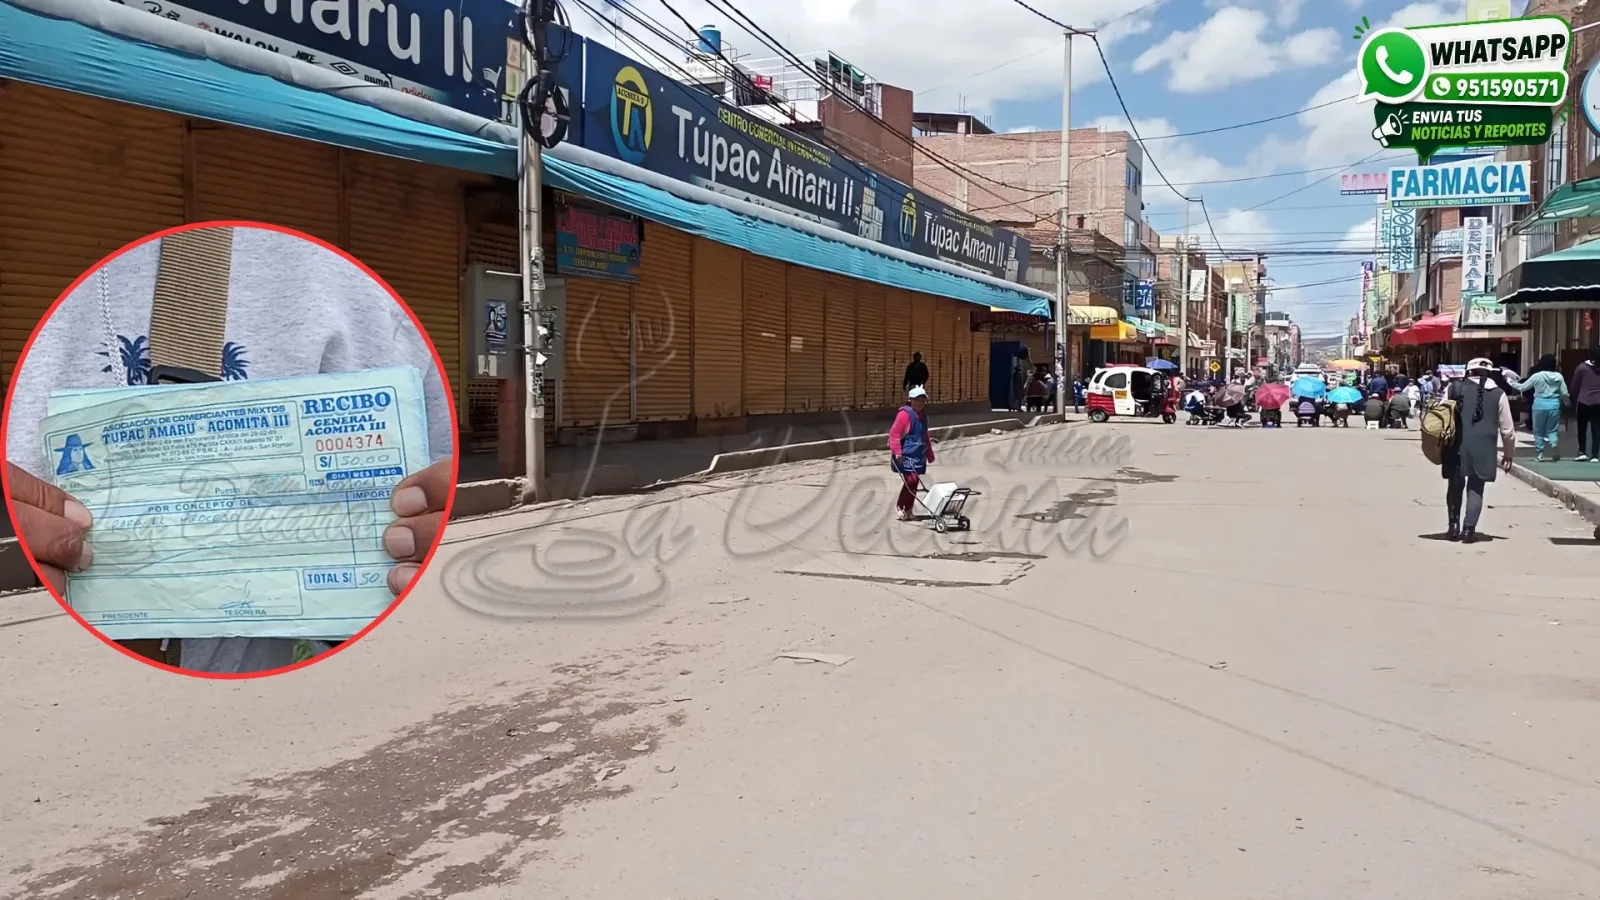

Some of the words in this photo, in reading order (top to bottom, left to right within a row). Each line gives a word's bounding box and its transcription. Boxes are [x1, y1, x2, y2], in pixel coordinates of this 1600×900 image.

[237, 0, 420, 64] aru
[718, 107, 747, 132] CENTRO
[749, 122, 786, 149] COMERCIAL
[671, 104, 760, 182] Túpac
[766, 148, 837, 211] Amaru
[1391, 165, 1527, 197] FARMACIA
[924, 211, 960, 255] Túpac
[961, 229, 996, 264] Amaru
[1465, 219, 1483, 289] DENTAL
[303, 391, 392, 414] RECIBO
[159, 416, 171, 424] DE
[172, 408, 246, 423] COMERCIANTES
[247, 404, 286, 415] MIXTOS
[313, 414, 376, 427] GENERAL
[102, 428, 144, 444] TUPAC
[149, 422, 195, 438] AMARU
[208, 416, 269, 432] ACOMITA
[273, 414, 289, 427] III
[305, 423, 365, 436] ACOMITA
[370, 421, 386, 431] III
[316, 434, 383, 452] 0004374
[320, 456, 332, 468] S/
[340, 455, 389, 466] 50.00
[215, 487, 240, 495] Puesto
[309, 479, 325, 487] FECHA
[353, 490, 391, 499] IMPORT
[175, 501, 233, 512] CONCEPTO
[112, 520, 141, 530] PARA
[152, 518, 165, 526] EL
[181, 514, 240, 525] PROCESO
[307, 573, 340, 584] TOTAL
[342, 572, 352, 584] S/
